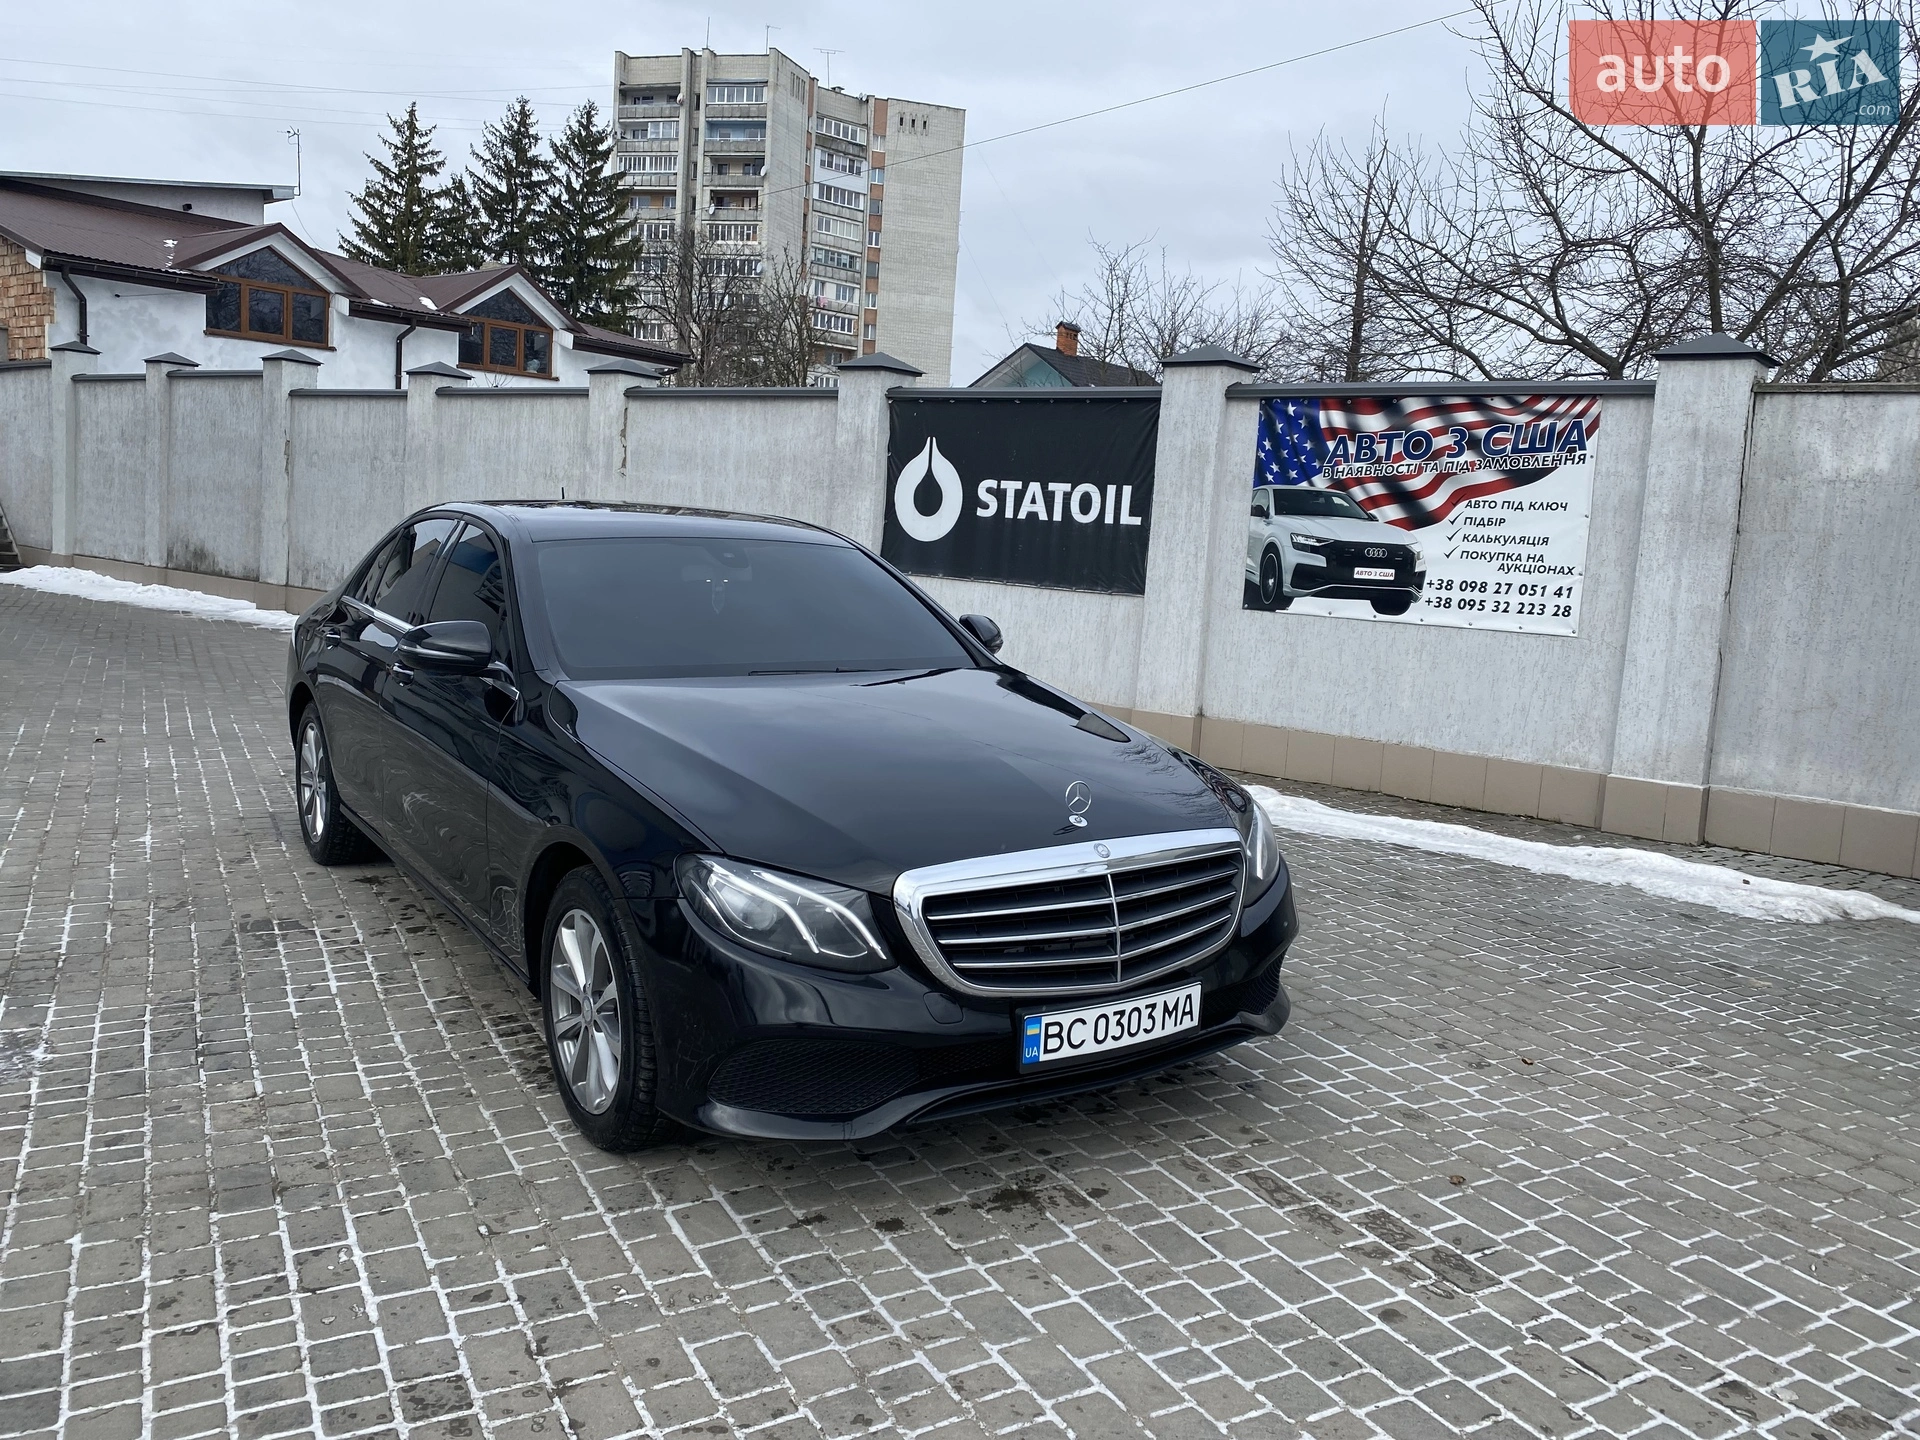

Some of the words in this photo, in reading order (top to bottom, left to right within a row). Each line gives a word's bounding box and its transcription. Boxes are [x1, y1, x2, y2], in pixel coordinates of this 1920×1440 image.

[1325, 430, 1433, 465] АВТО
[1482, 419, 1588, 455] США
[1323, 467, 1332, 479] В
[1334, 463, 1419, 478] НАЯВНОСТІ
[1423, 462, 1439, 473] ТА
[1442, 462, 1470, 474] ПІД
[1476, 454, 1586, 470] ЗАМОВЛЕННЯ
[977, 479, 1142, 525] STATOIL
[1465, 500, 1497, 509] АВТО
[1501, 501, 1524, 511] ПІД
[1529, 502, 1568, 511] КЛЮЧ
[1464, 517, 1506, 527] ПІДБІР
[1462, 534, 1549, 547] КАЛЬКУЛЯЦІЯ
[1460, 551, 1522, 562] ПОКУПКА
[1526, 554, 1544, 563] НА
[1497, 563, 1575, 575] АУКЦІОНАХ
[1426, 579, 1454, 591] +38
[1459, 580, 1488, 593] 098
[1493, 583, 1513, 594] 27
[1519, 584, 1547, 597] 051
[1554, 586, 1573, 598] 41
[1425, 597, 1452, 608] +38
[1458, 599, 1486, 611] 095
[1492, 601, 1510, 613] 32
[1516, 603, 1546, 615] 223
[1552, 605, 1572, 617] 28
[1026, 1046, 1038, 1058] UA
